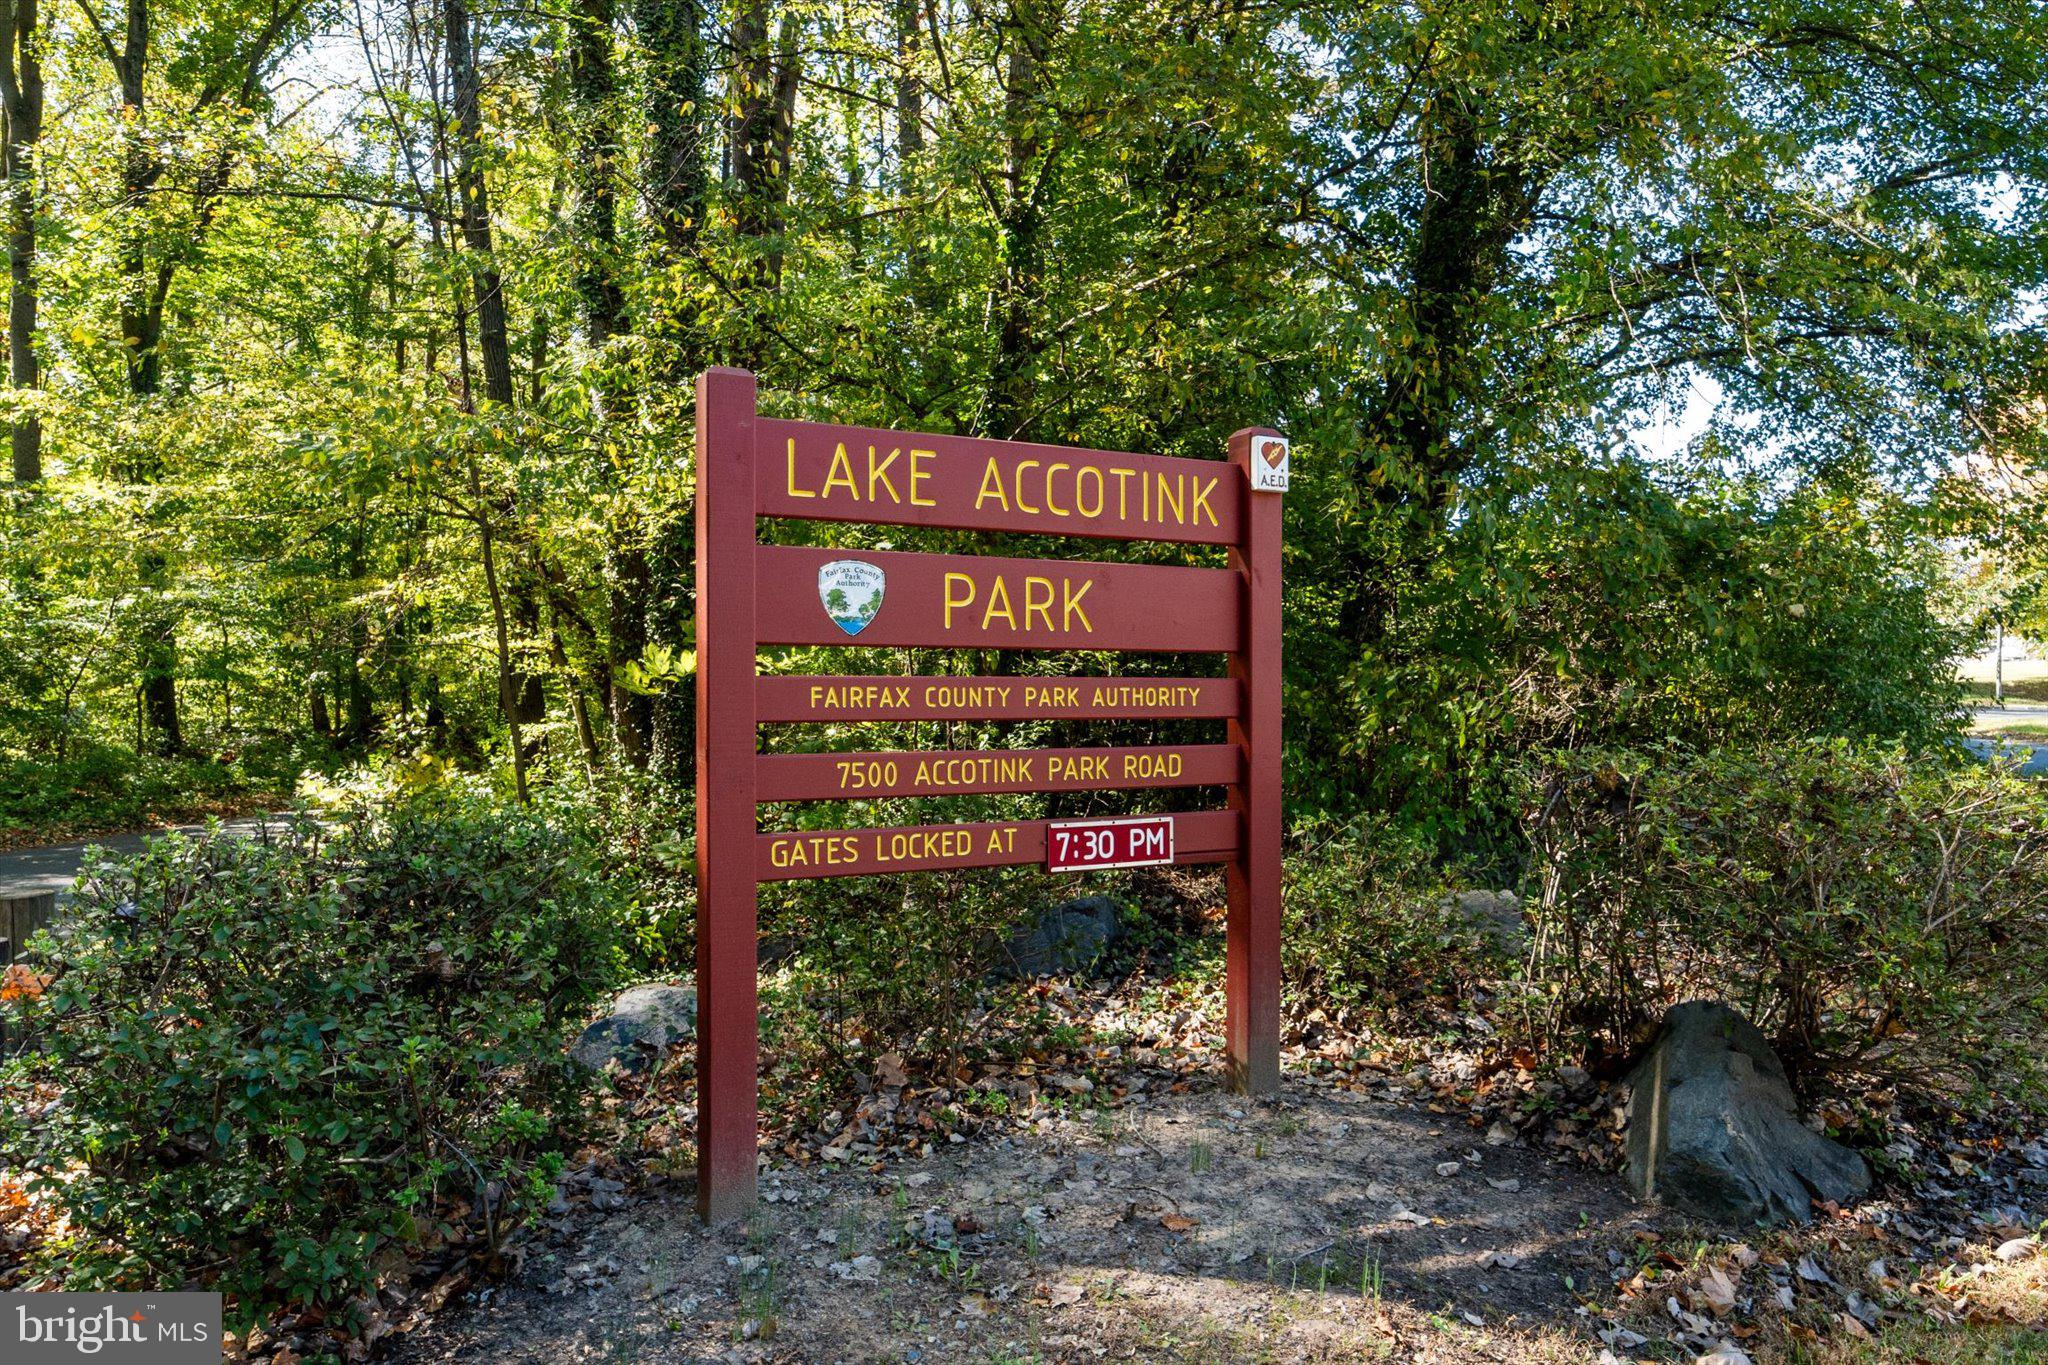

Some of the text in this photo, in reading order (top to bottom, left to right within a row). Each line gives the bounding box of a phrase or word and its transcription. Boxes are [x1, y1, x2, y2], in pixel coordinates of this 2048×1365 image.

[786, 437, 1219, 527] LAKE ACCOTINK
[1261, 475, 1287, 487] A.E.D.
[854, 567, 880, 580] County
[944, 572, 1093, 633] PARK
[811, 686, 1200, 708] FAIRFAX COUNTY PARK AUTHORITY
[837, 754, 1181, 788] 7500 ACCOTINK PARK ROAD
[771, 828, 1017, 867] GATES LOCKED AT
[1055, 826, 1165, 861] 7:30 PM
